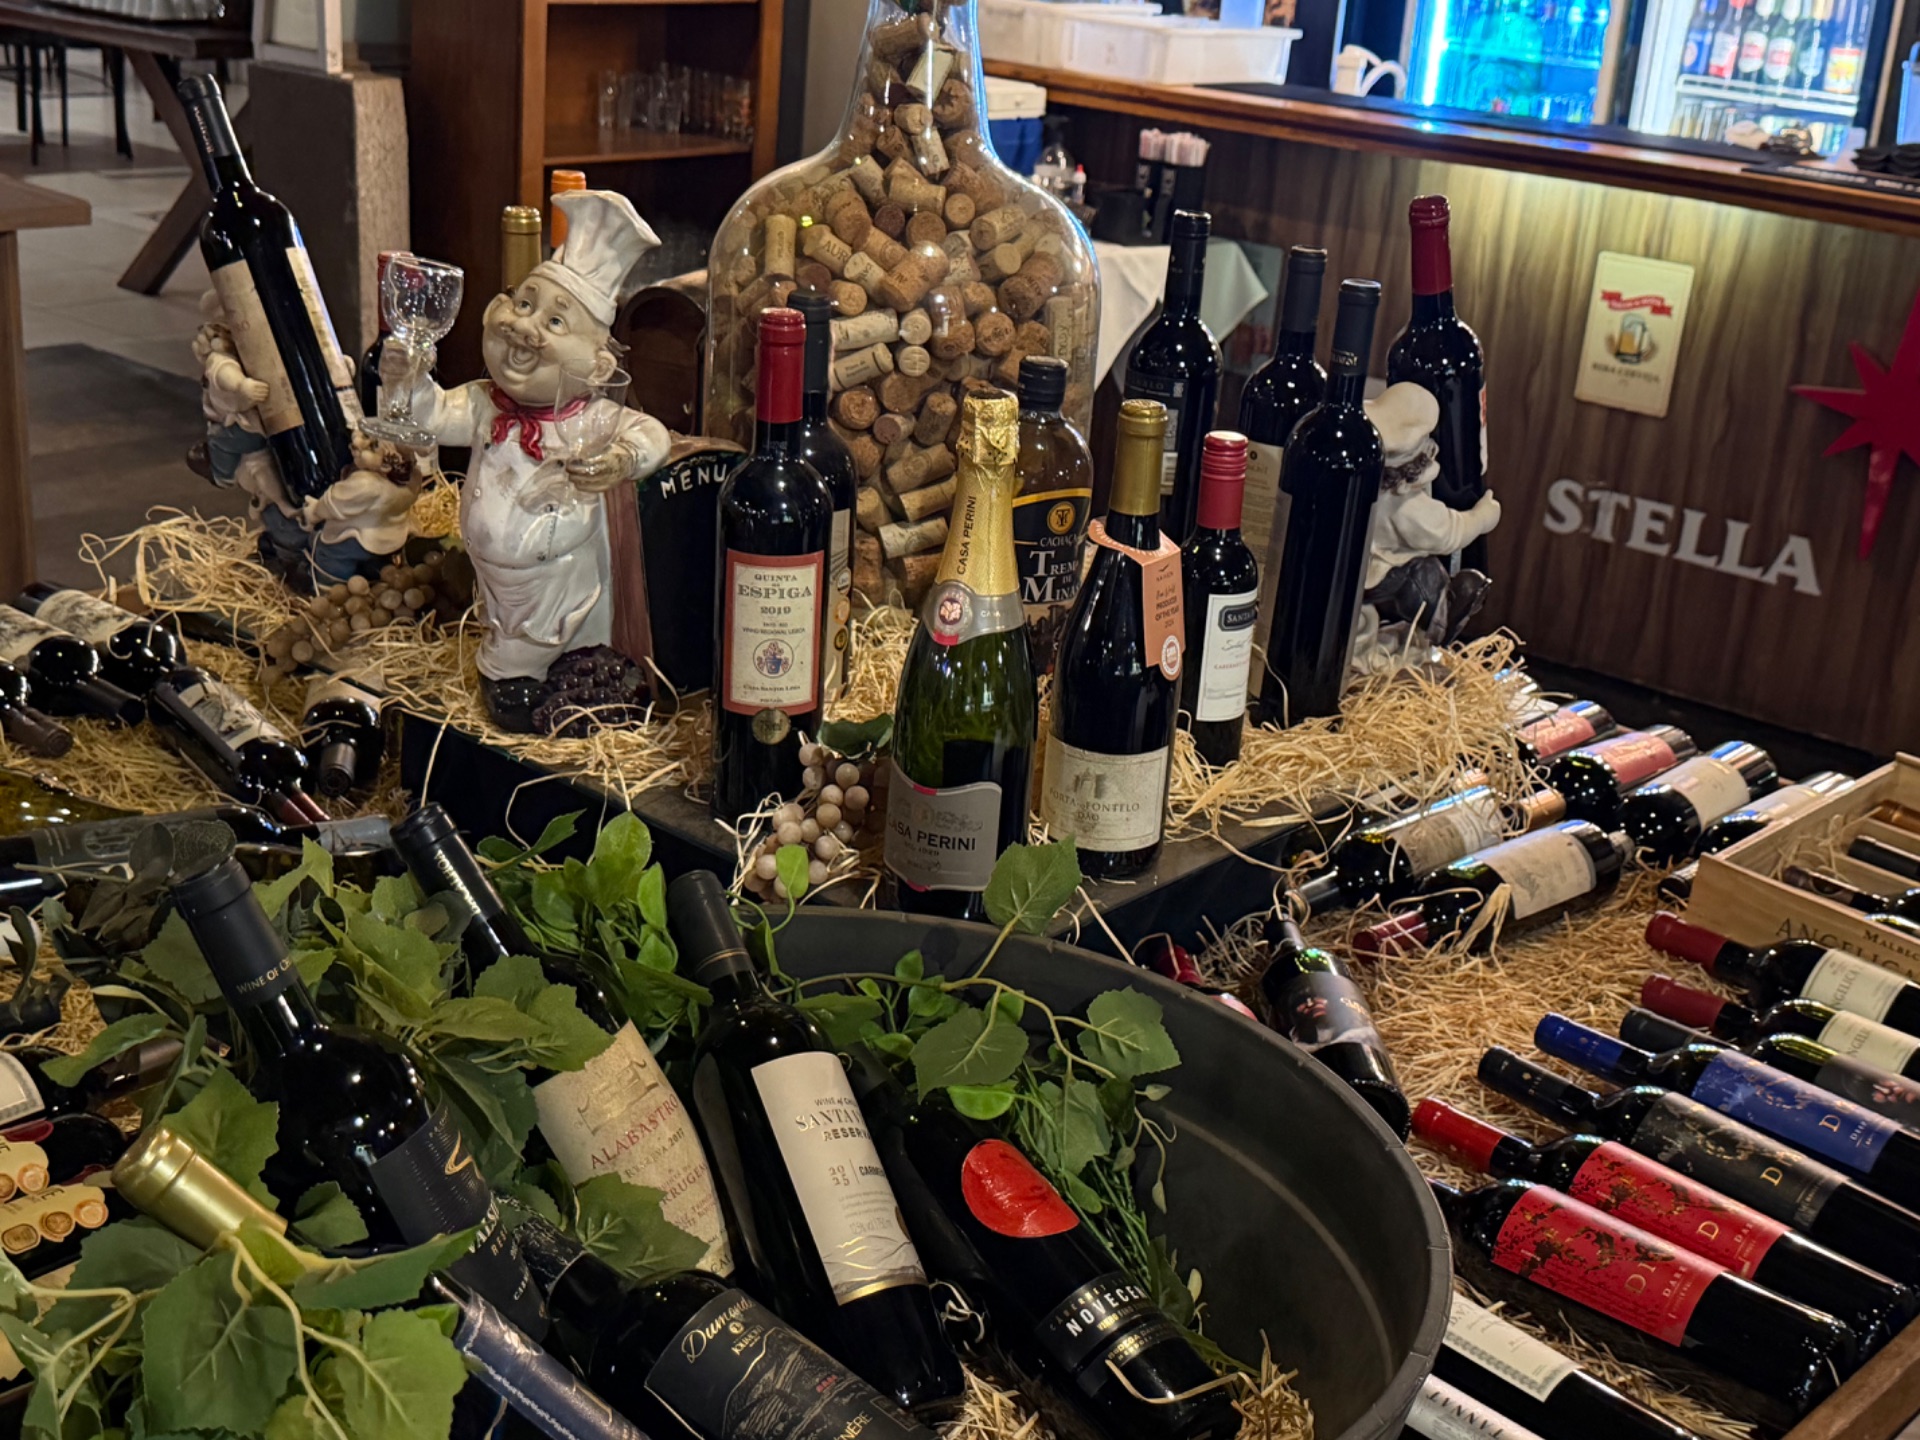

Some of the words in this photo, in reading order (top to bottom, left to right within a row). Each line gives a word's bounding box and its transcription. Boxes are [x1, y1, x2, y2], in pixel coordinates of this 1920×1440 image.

[660, 463, 727, 500] MENU
[963, 495, 978, 539] PERINI
[1543, 478, 1822, 597] STELLA
[957, 541, 972, 576] CASA
[738, 584, 812, 600] ESPIGA
[754, 574, 797, 582] QUINTA
[760, 605, 792, 615] 2019
[1085, 801, 1140, 813] FONTELO
[916, 830, 977, 851] PERINI
[236, 975, 266, 994] WINE
[266, 967, 279, 981] OF
[1831, 969, 1862, 1008] NGELICA
[815, 1097, 835, 1107] WINE
[590, 1093, 680, 1170] ALABASTRO
[625, 1145, 668, 1179] RESERVA
[668, 1127, 685, 1148] 2017
[1425, 1381, 1504, 1439] TANNAT
